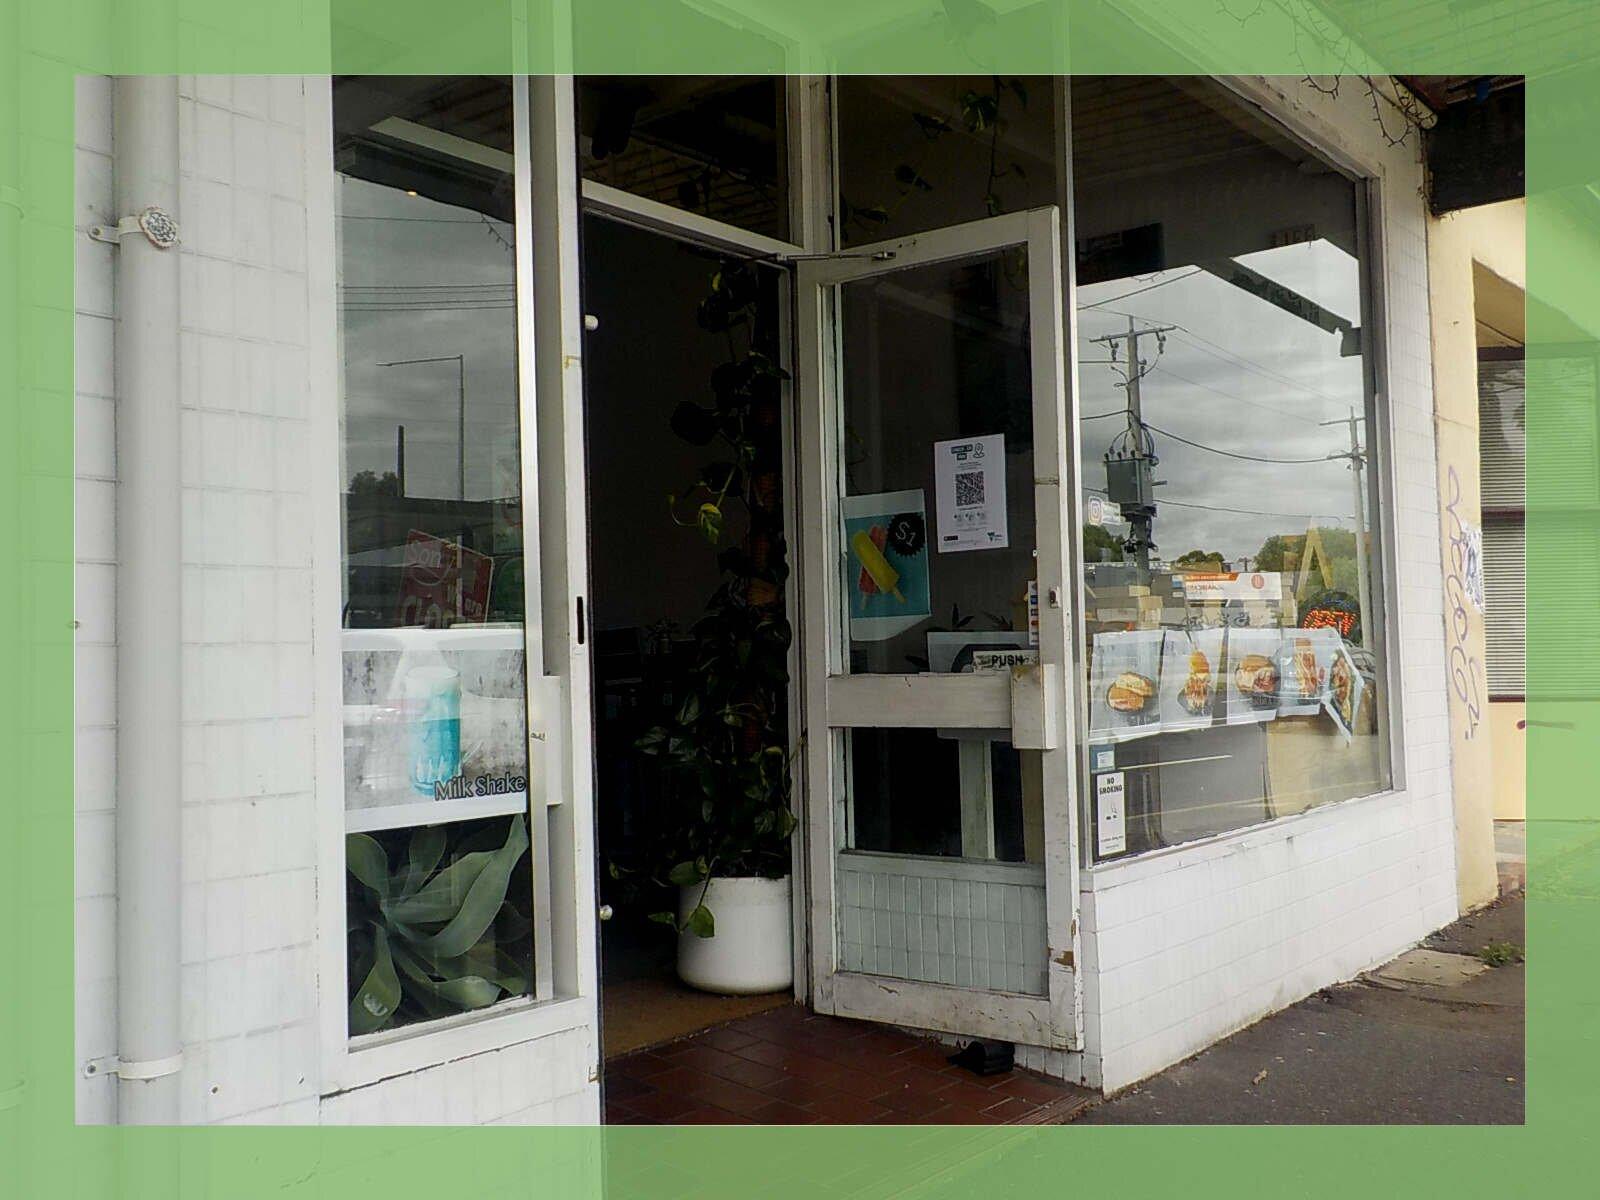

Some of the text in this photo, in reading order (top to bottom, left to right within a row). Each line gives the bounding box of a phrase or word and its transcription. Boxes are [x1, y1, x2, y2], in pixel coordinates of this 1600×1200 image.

[991, 654, 1023, 667] PUSH
[434, 772, 527, 801] Milk Shake
[1106, 777, 1115, 785] NO
[1099, 784, 1123, 795] SMOKING
